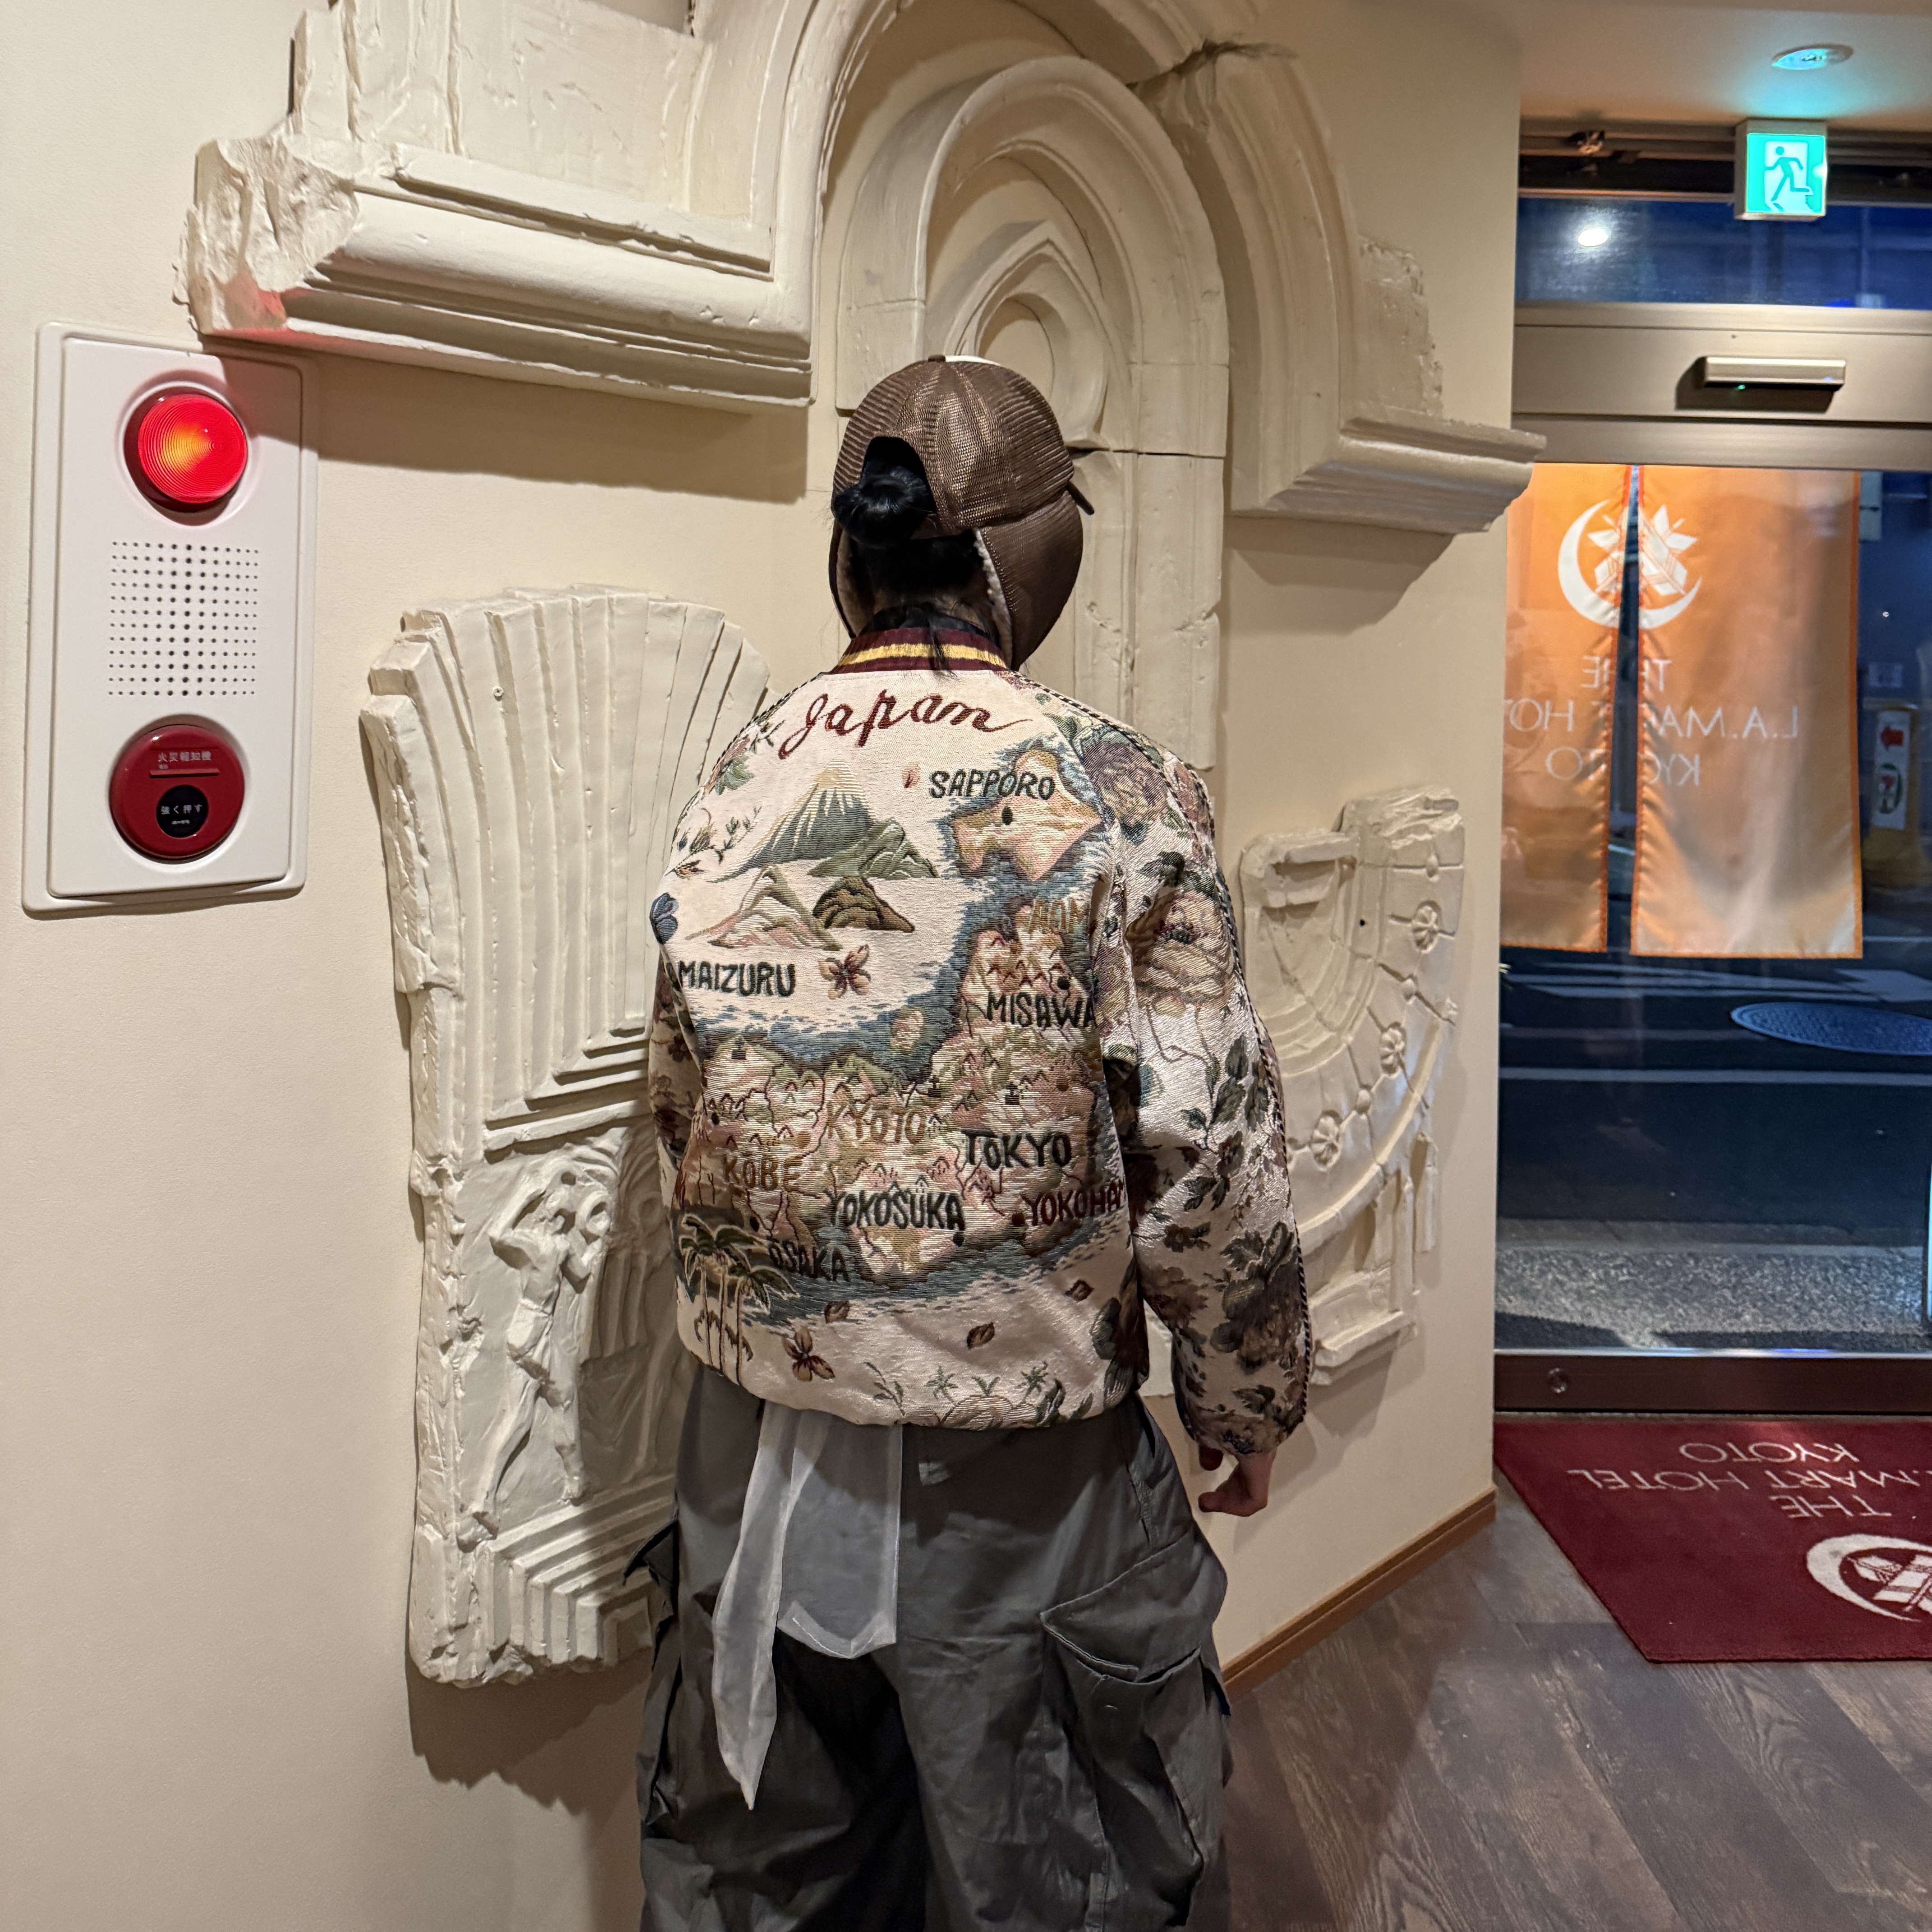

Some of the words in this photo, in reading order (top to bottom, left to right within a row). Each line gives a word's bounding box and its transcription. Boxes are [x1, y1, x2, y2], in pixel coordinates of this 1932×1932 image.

[778, 689, 1033, 759] Japan
[928, 769, 1056, 800] SAPPORO
[160, 804, 203, 815] 強く押す
[678, 961, 796, 996] MAIZURU
[826, 1101, 927, 1145] KYOTO
[960, 1128, 1072, 1171] TOKYO
[723, 1153, 803, 1192] KOBE
[823, 1188, 965, 1232] YOKOSUKA
[768, 1239, 851, 1282] OSAKA
[1679, 1442, 1860, 1463] KYOTO
[1566, 1469, 1749, 1491] HOTEL
[1764, 1469, 1932, 1488] .MART
[1769, 1495, 1892, 1518] THE
